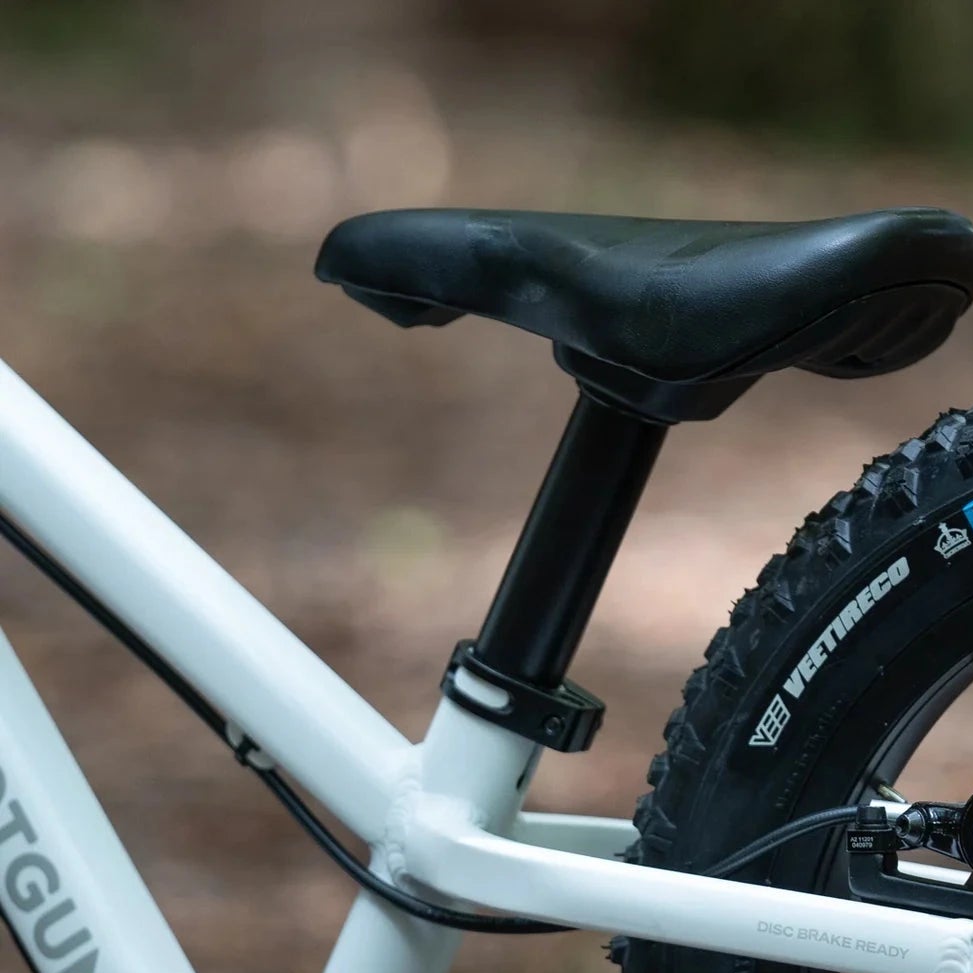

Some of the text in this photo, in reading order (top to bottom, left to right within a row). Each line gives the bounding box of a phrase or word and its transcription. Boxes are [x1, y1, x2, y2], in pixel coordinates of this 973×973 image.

[757, 921, 910, 960] DISC BRAKE READY
